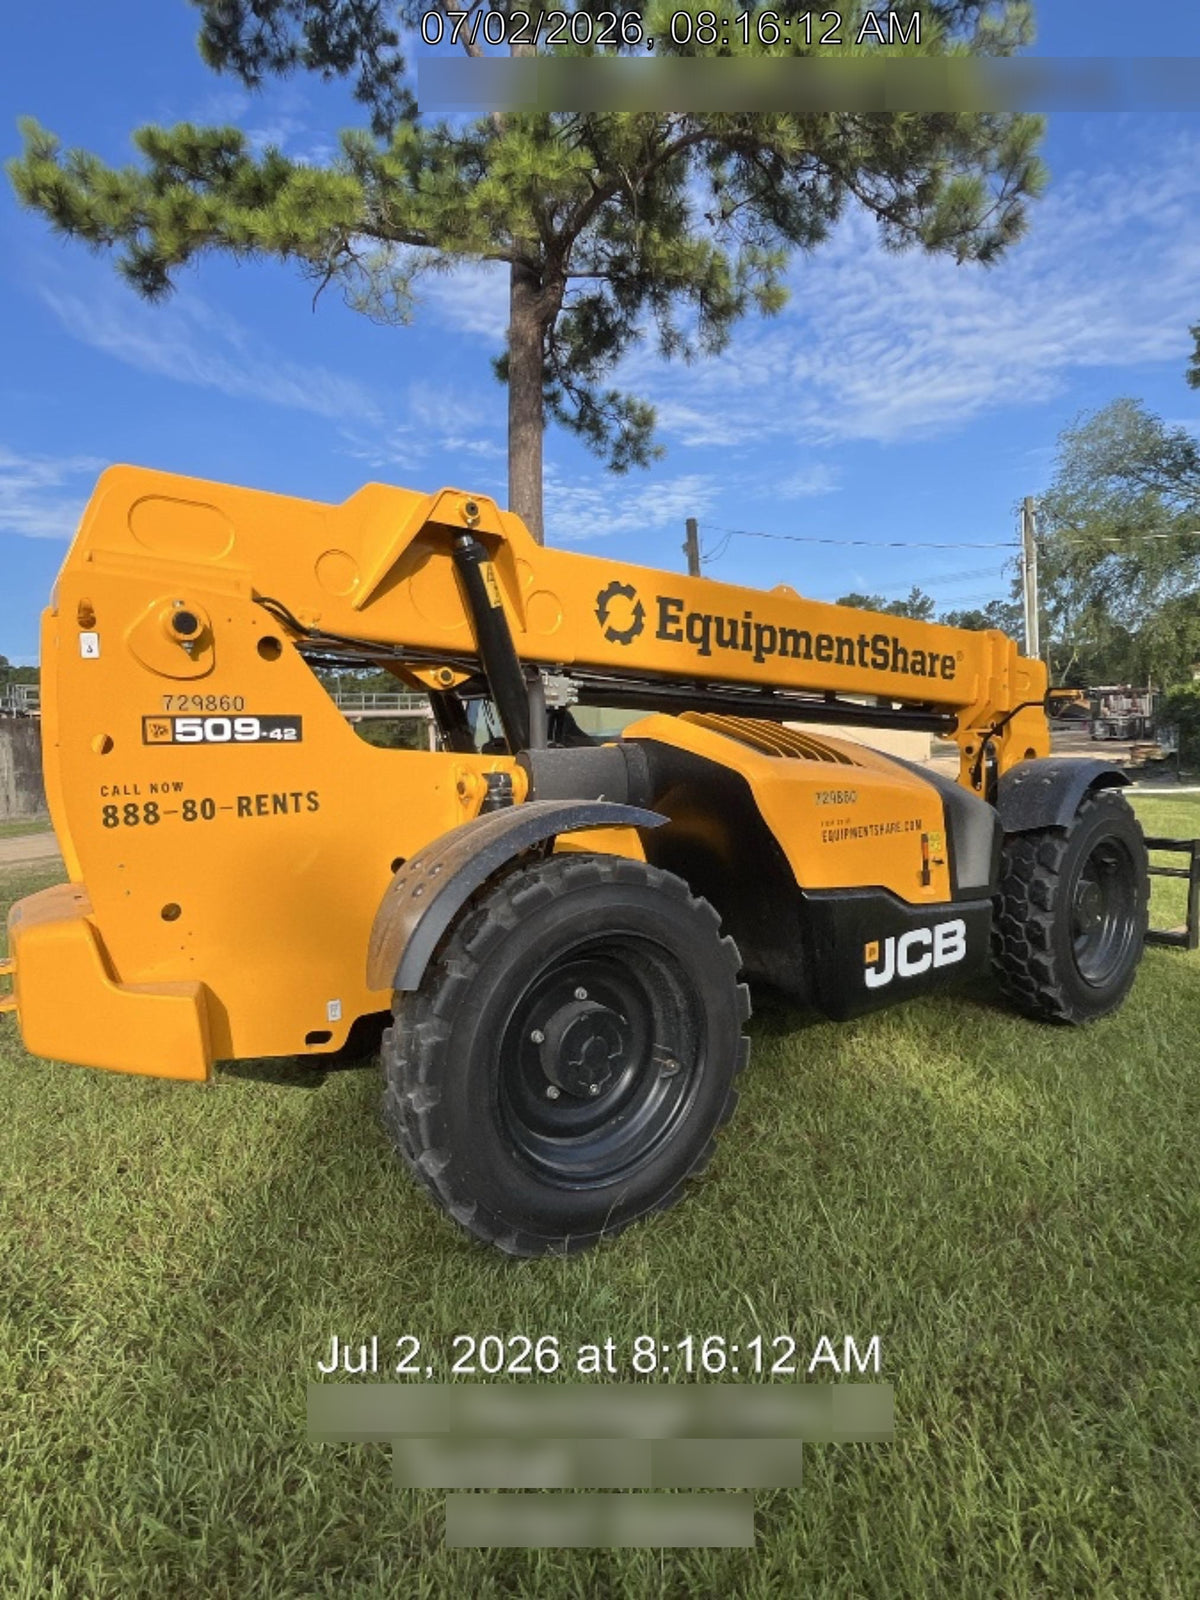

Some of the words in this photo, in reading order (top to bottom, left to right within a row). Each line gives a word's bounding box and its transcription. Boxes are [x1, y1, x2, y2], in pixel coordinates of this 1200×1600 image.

[655, 595, 957, 681] EquipmentShare
[162, 694, 245, 711] 729860
[174, 716, 298, 743] 509-42
[100, 783, 141, 797] CALL
[150, 780, 185, 795] NOW
[101, 790, 321, 829] 888-80-RENTS
[864, 918, 967, 989] JCB
